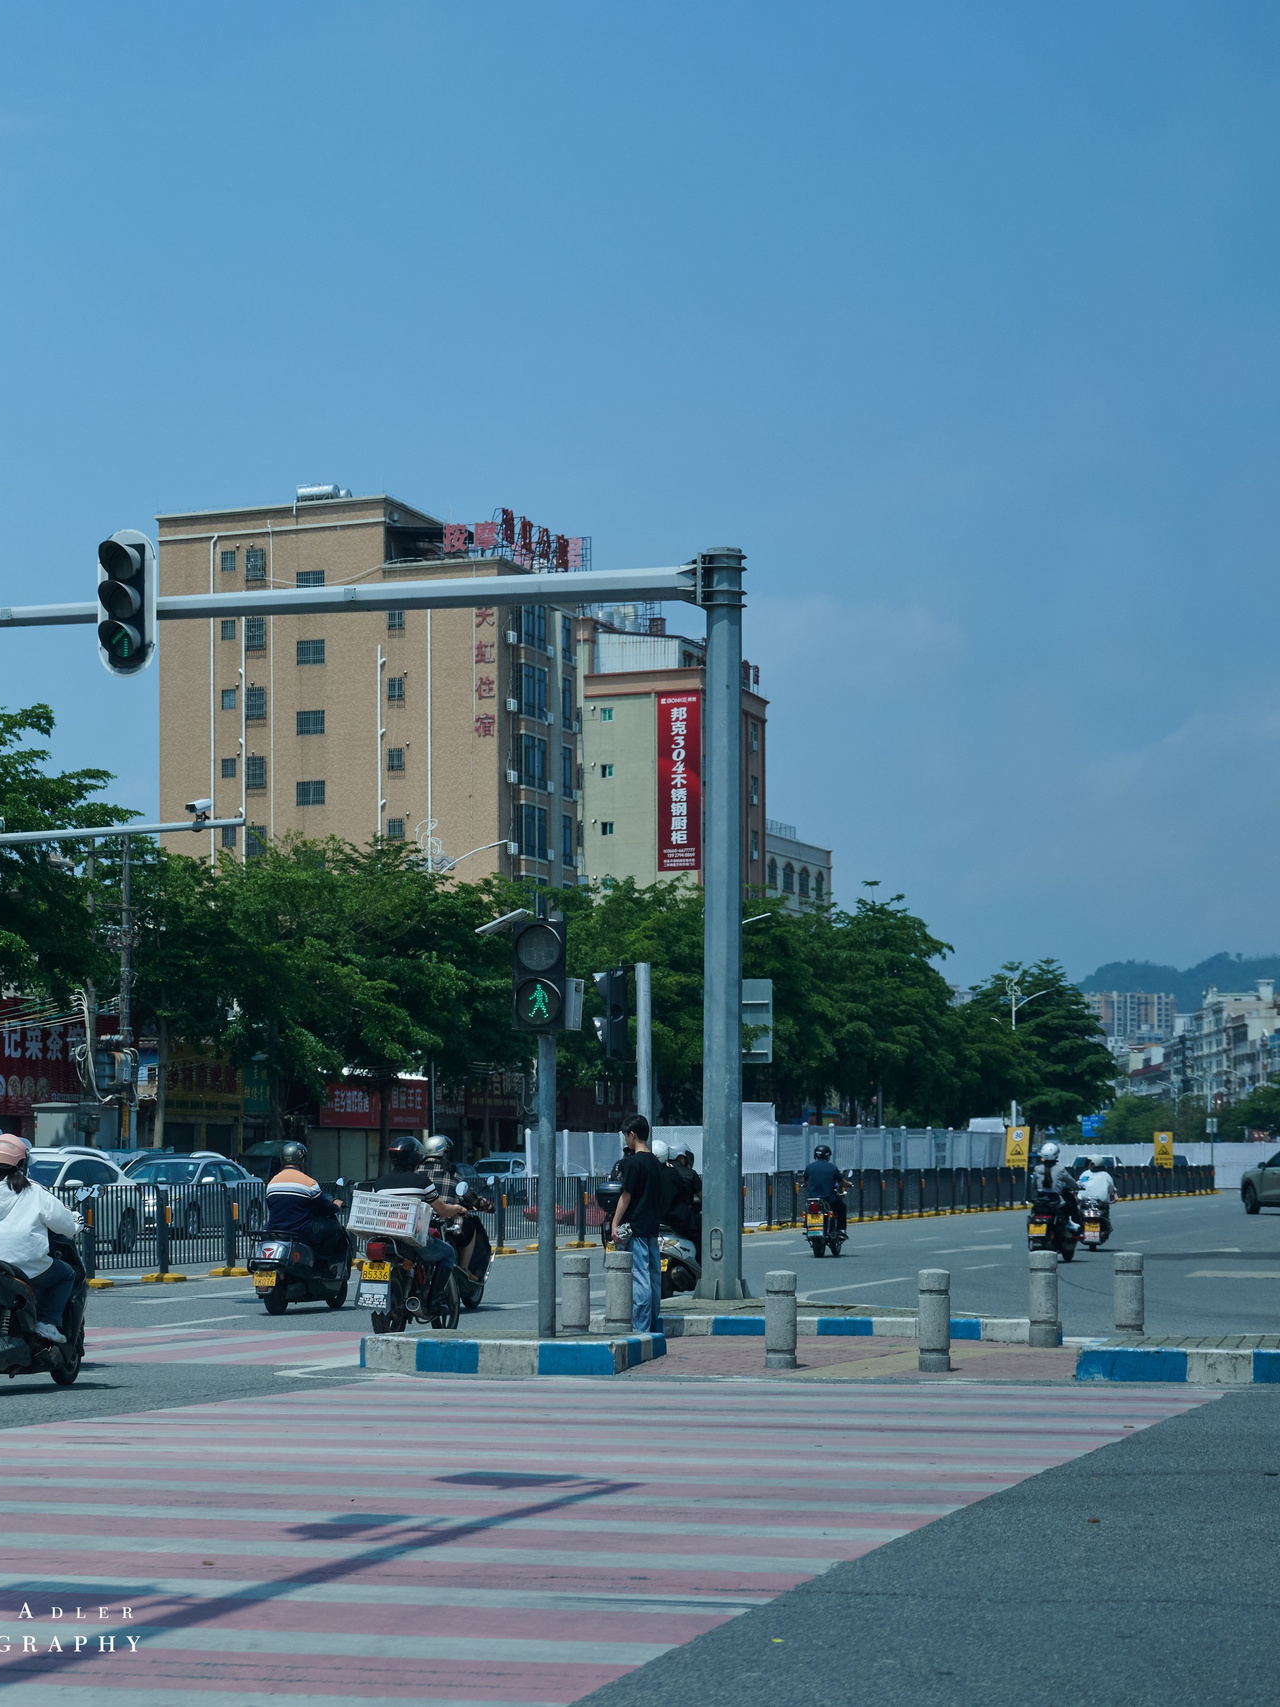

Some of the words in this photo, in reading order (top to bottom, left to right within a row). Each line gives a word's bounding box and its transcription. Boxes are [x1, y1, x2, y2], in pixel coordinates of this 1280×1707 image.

[442, 520, 499, 553] 按摩
[670, 707, 688, 845] 邦克304不锈钢厨柜
[362, 1270, 388, 1280] B5336
